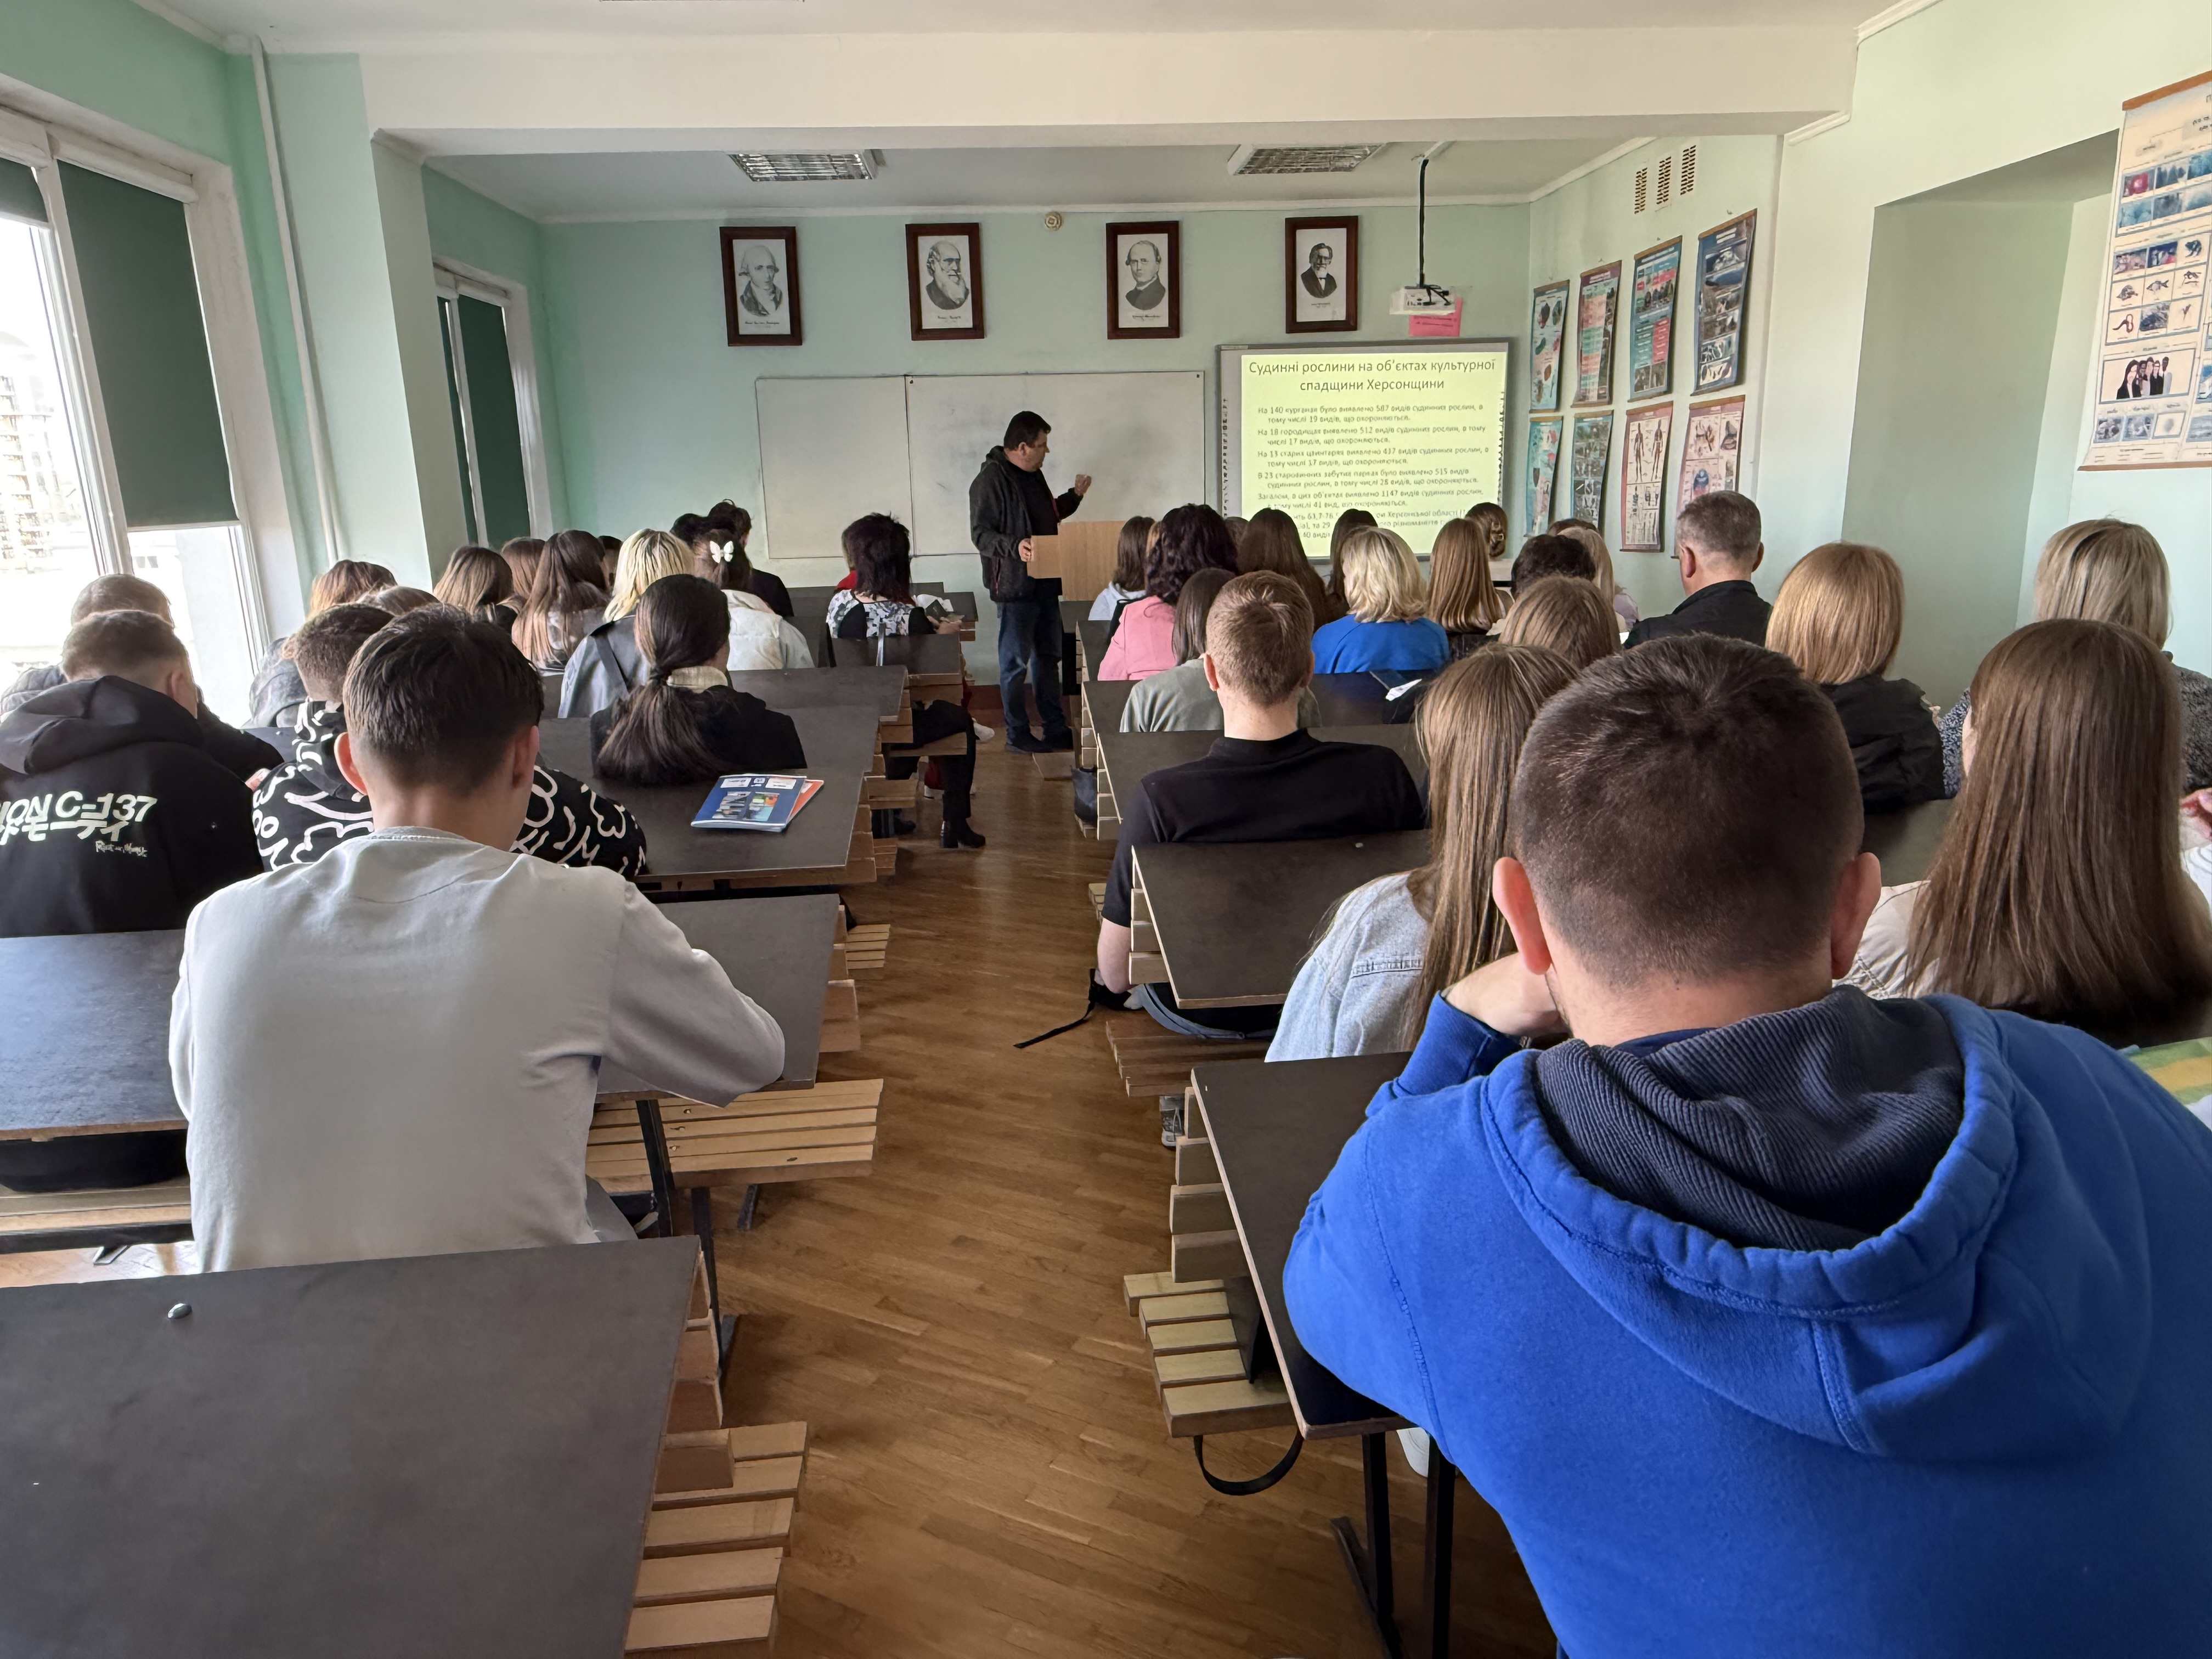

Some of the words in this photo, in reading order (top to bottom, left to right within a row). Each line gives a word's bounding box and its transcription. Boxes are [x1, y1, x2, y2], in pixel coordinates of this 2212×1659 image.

[1249, 361, 1299, 375] Судинні
[1302, 362, 1355, 374] рослини
[1359, 362, 1372, 371] на
[1431, 359, 1496, 373] культурної
[1300, 381, 1363, 393] спадщини
[1367, 379, 1444, 391] Херсонщини
[0, 794, 53, 823] ION
[55, 791, 157, 822] C-137
